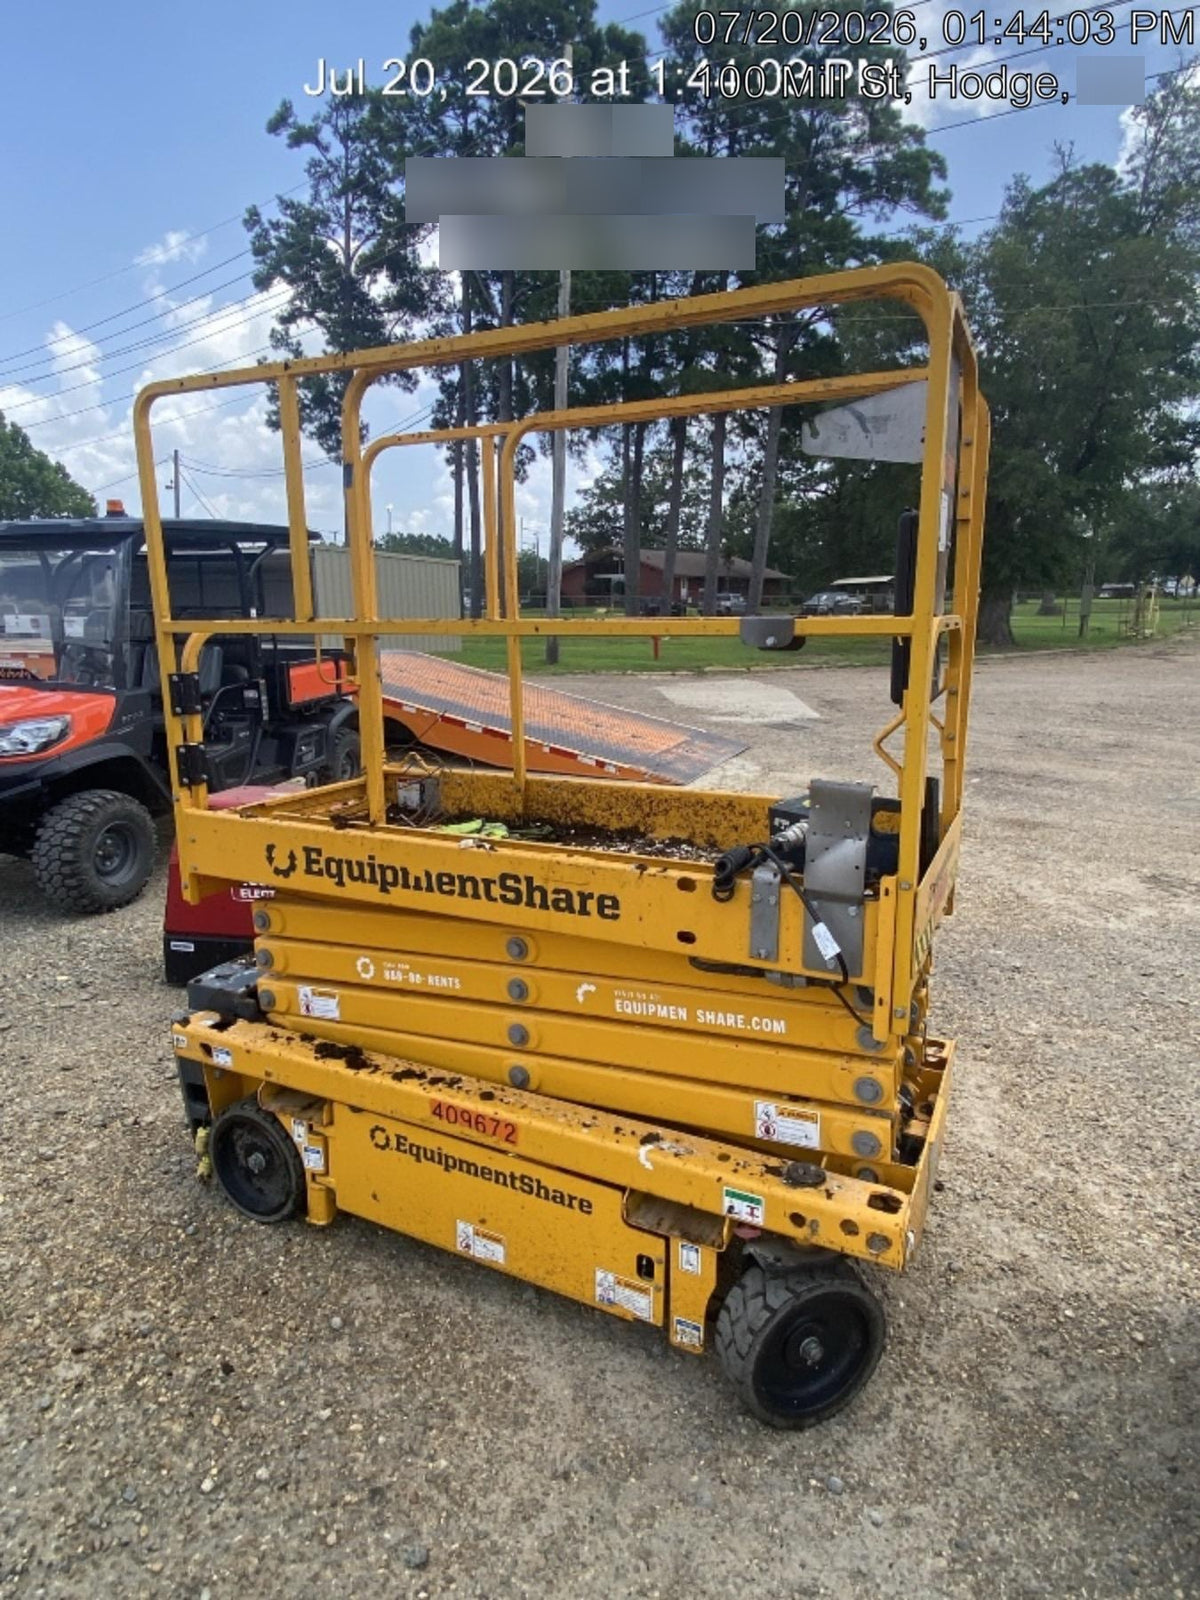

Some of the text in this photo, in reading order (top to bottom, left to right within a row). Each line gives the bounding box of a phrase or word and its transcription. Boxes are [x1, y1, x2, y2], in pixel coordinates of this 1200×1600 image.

[302, 845, 621, 922] EquipmentShare
[431, 1101, 517, 1145] 409672
[394, 1133, 594, 1216] EquipmentShare
